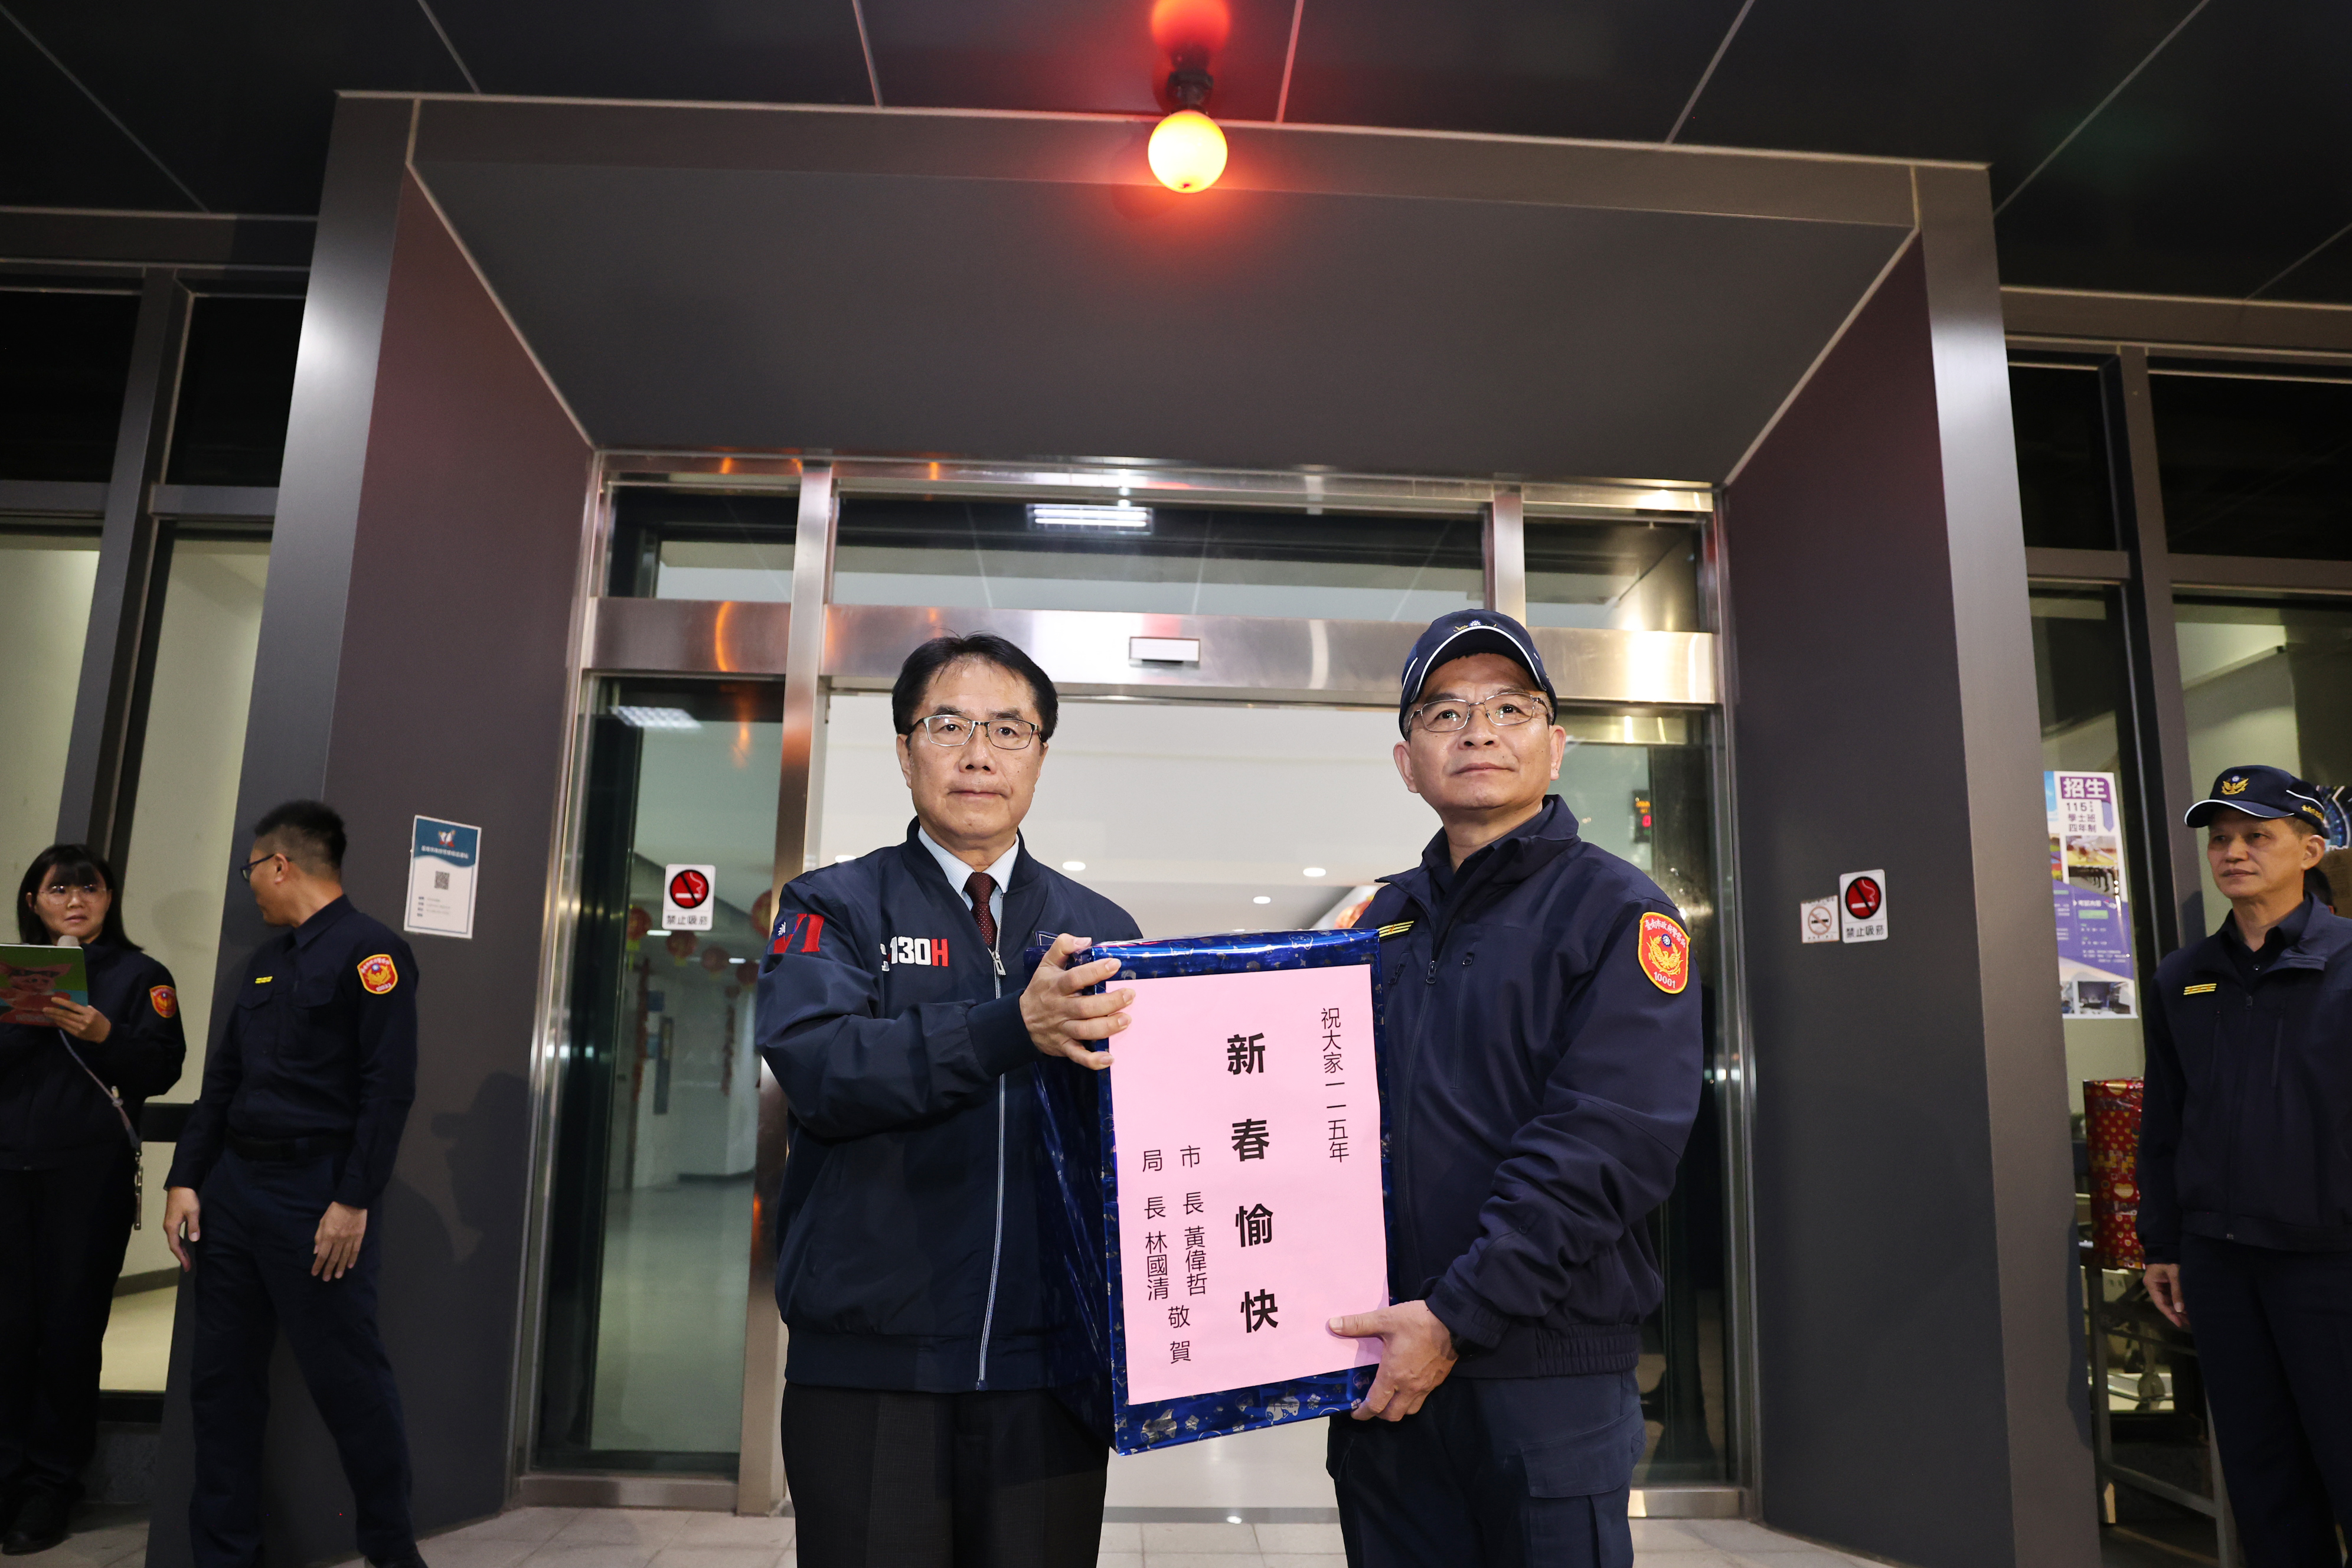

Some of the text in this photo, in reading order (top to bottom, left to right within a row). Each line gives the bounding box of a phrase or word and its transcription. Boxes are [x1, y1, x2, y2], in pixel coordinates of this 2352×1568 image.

[2063, 778, 2107, 798] 招生
[2066, 802, 2088, 811] 115
[1654, 972, 1675, 988] 10001
[1321, 1008, 1350, 1163] 祝大家一一五年
[1227, 1032, 1279, 1334] 新春愉快
